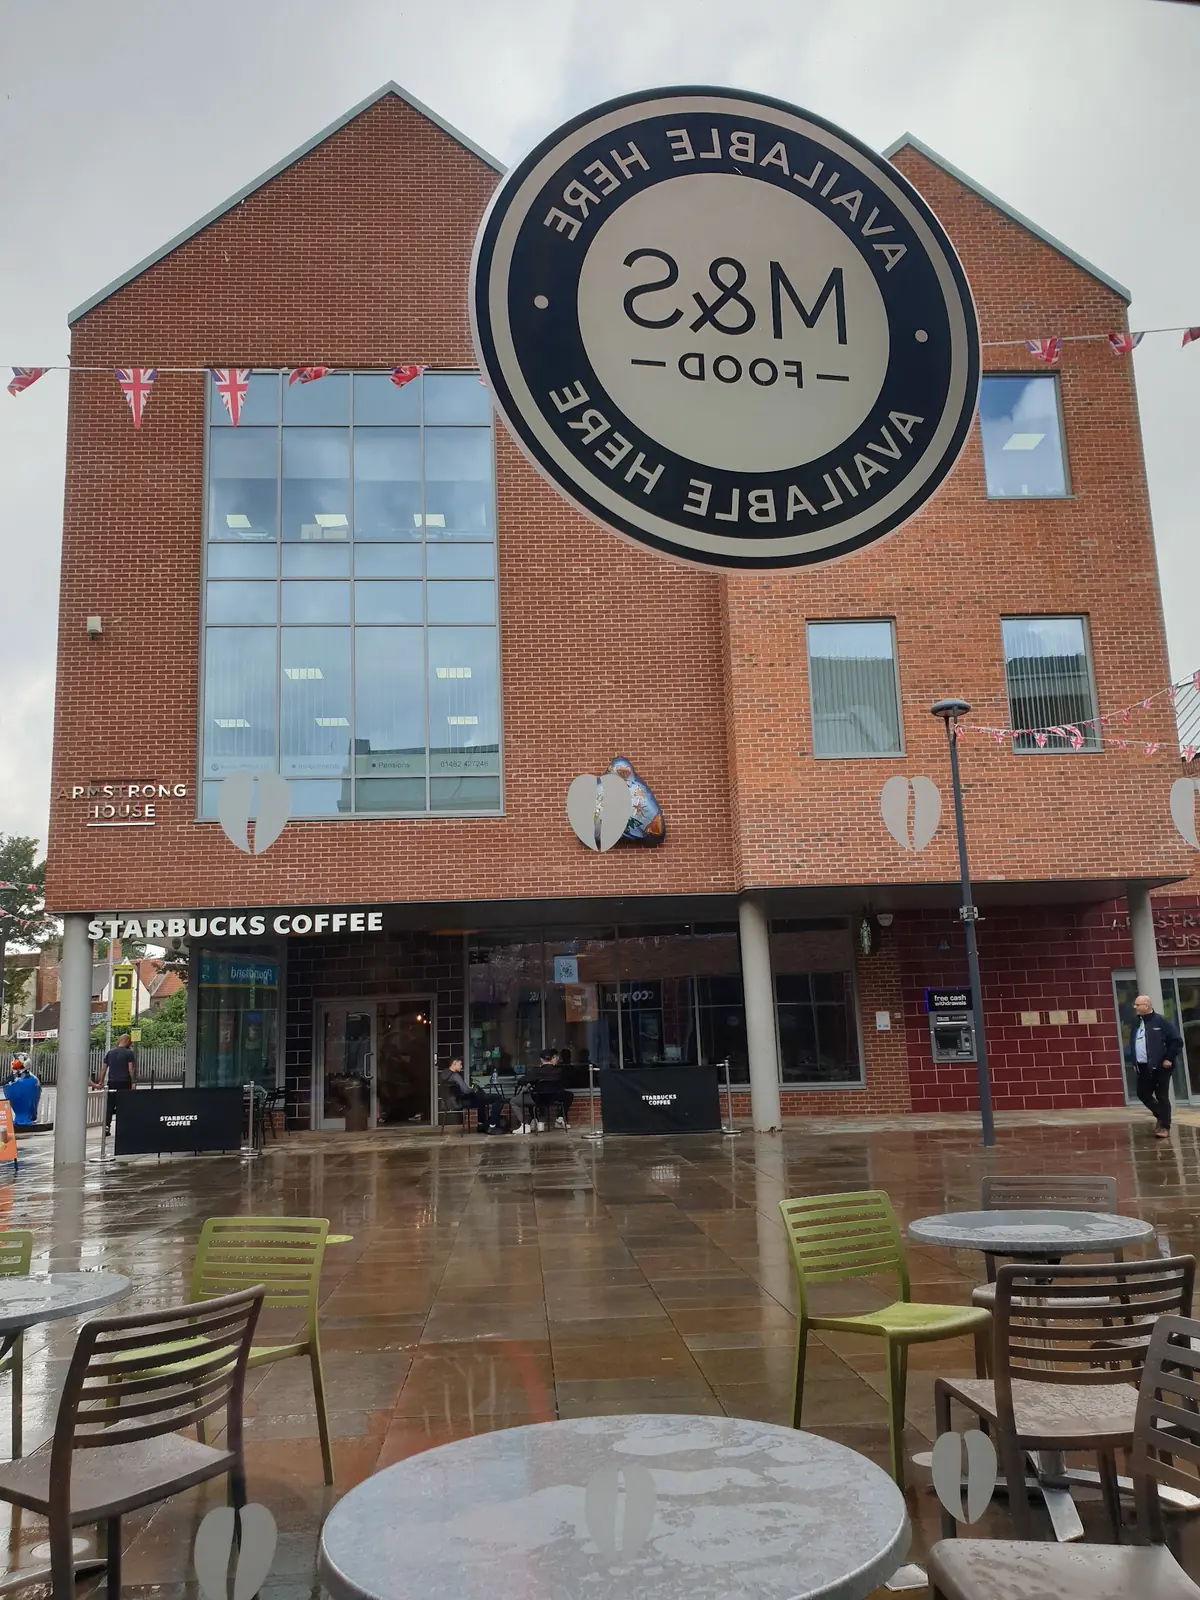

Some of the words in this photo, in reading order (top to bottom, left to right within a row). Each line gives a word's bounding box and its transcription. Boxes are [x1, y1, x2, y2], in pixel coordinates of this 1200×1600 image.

[378, 761, 410, 769] Pensions
[58, 783, 187, 800] ARMSTRONG
[87, 803, 156, 818] HOUSE
[88, 915, 266, 939] STARBUCKS
[273, 912, 383, 934] COFFEE
[118, 975, 128, 988] P
[934, 994, 949, 1002] free
